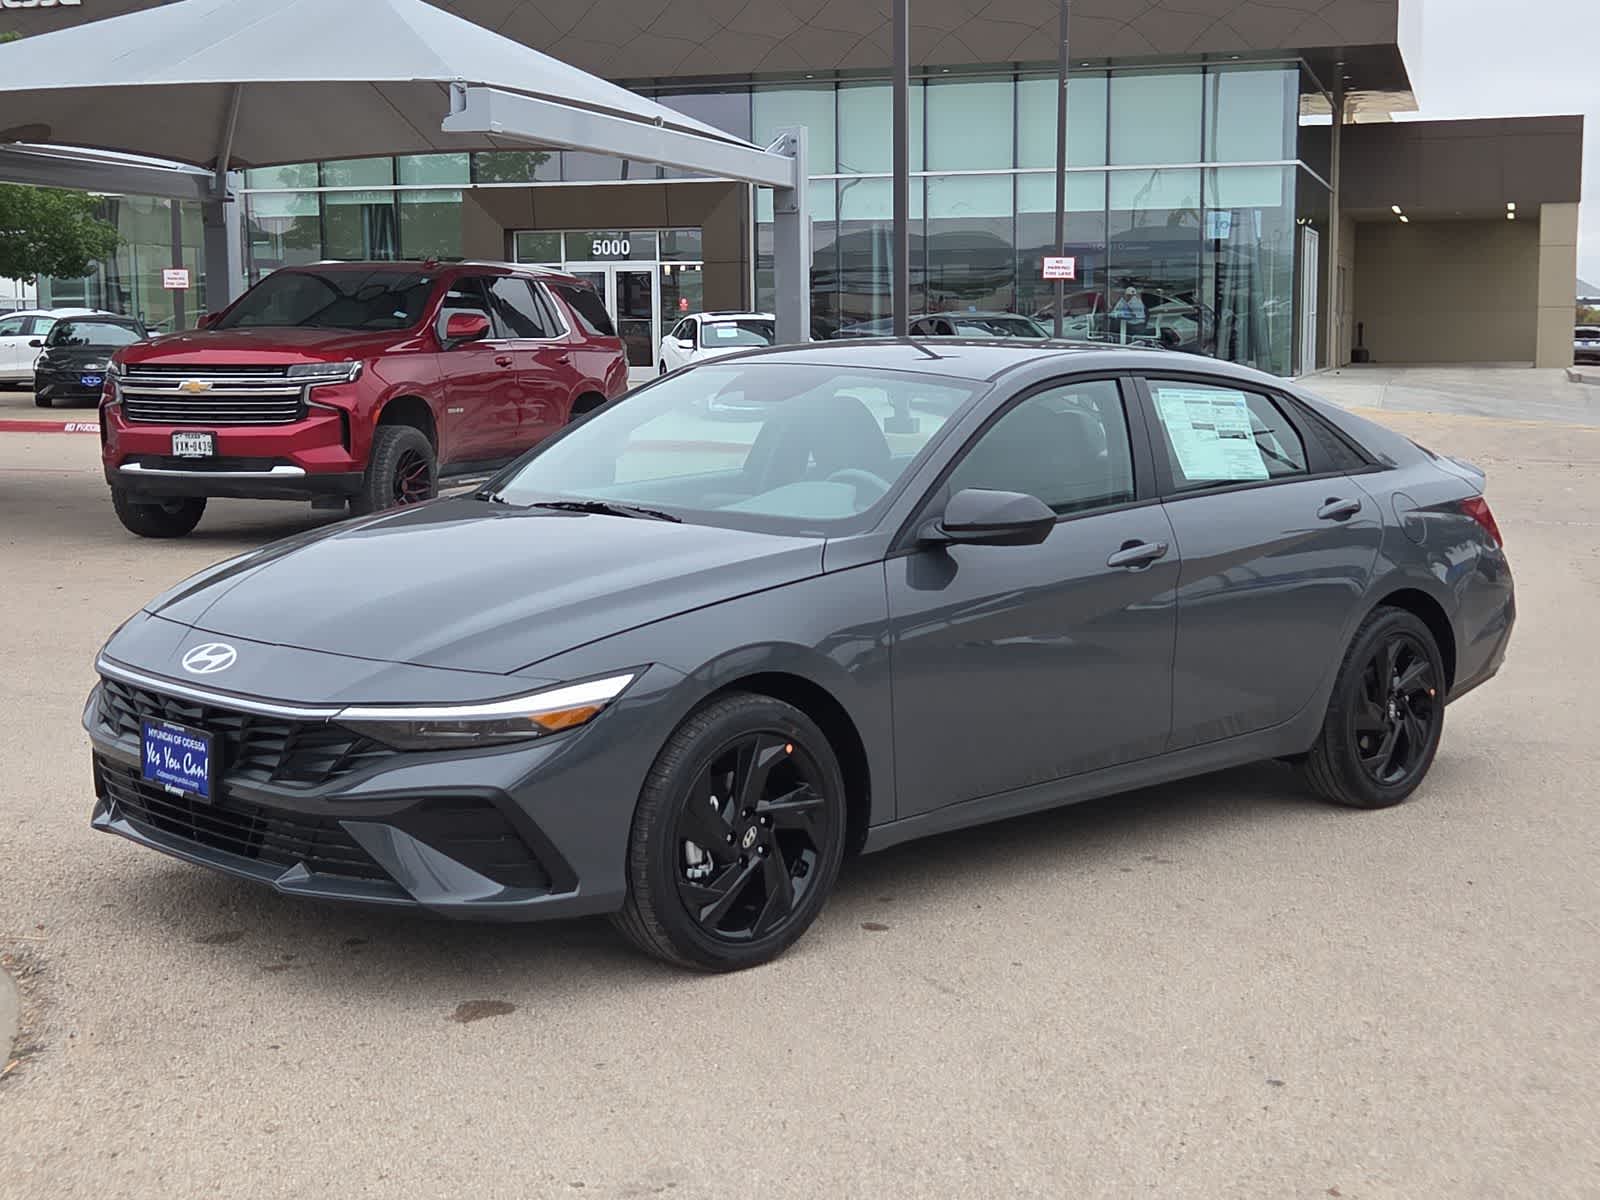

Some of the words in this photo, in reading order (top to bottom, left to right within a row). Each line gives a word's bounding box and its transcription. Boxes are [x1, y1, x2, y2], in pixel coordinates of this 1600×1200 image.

[592, 239, 630, 255] 5000
[174, 735, 181, 745] OF
[182, 738, 206, 752] ODESSA
[146, 741, 160, 765] Yes
[164, 746, 180, 770] You
[183, 752, 208, 780] Can!
